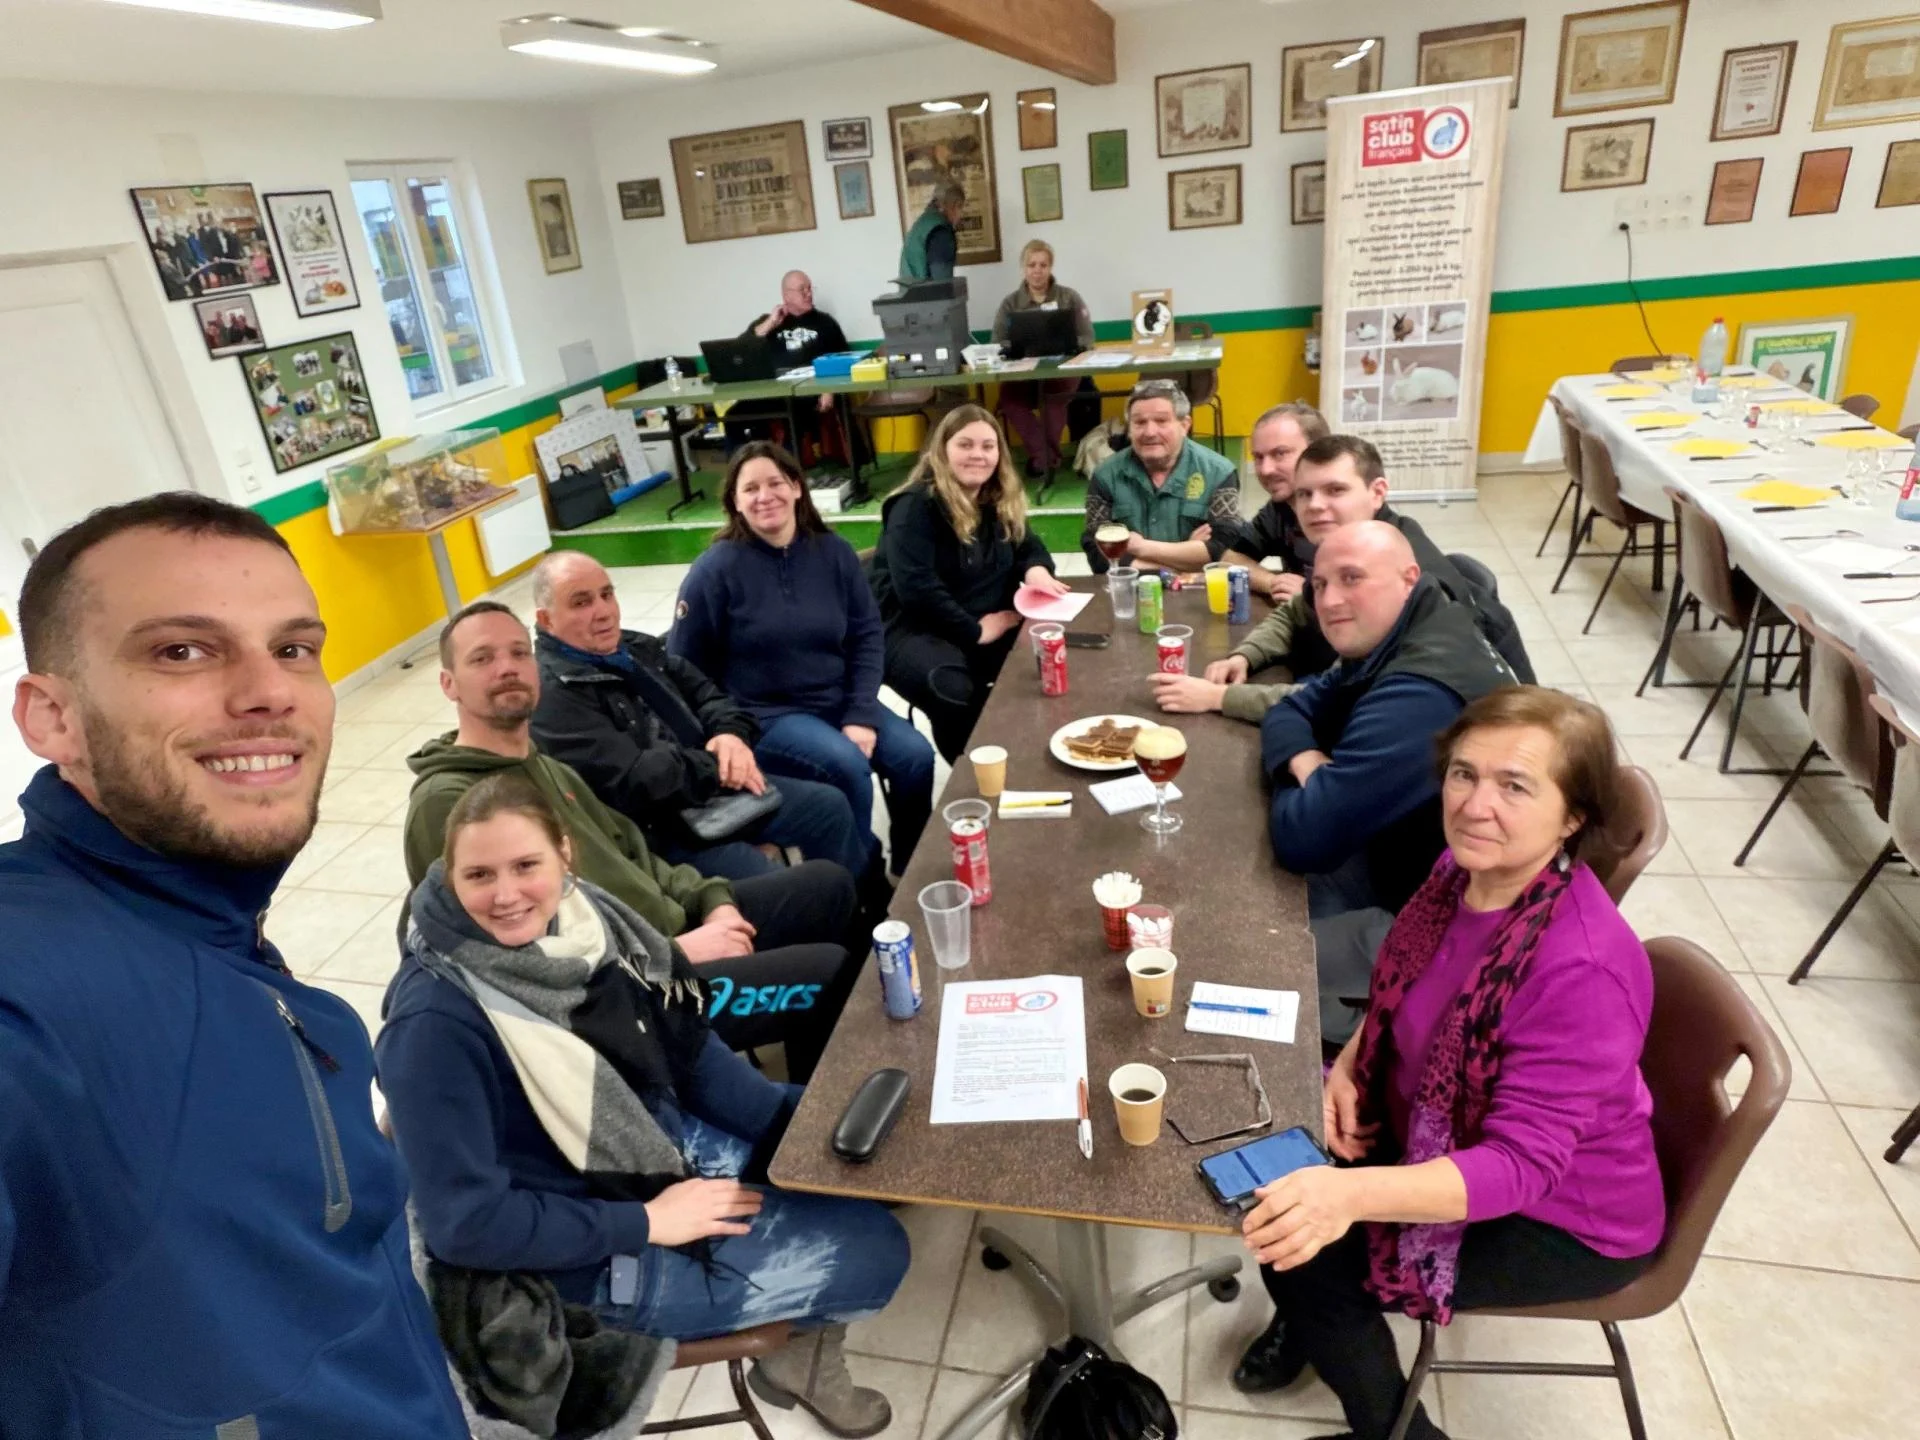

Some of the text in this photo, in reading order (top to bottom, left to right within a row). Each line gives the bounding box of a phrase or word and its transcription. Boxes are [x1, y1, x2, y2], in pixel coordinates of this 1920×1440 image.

[1369, 115, 1414, 133] satin
[1368, 130, 1415, 149] club
[1368, 147, 1413, 161] français
[730, 984, 822, 1016] asics
